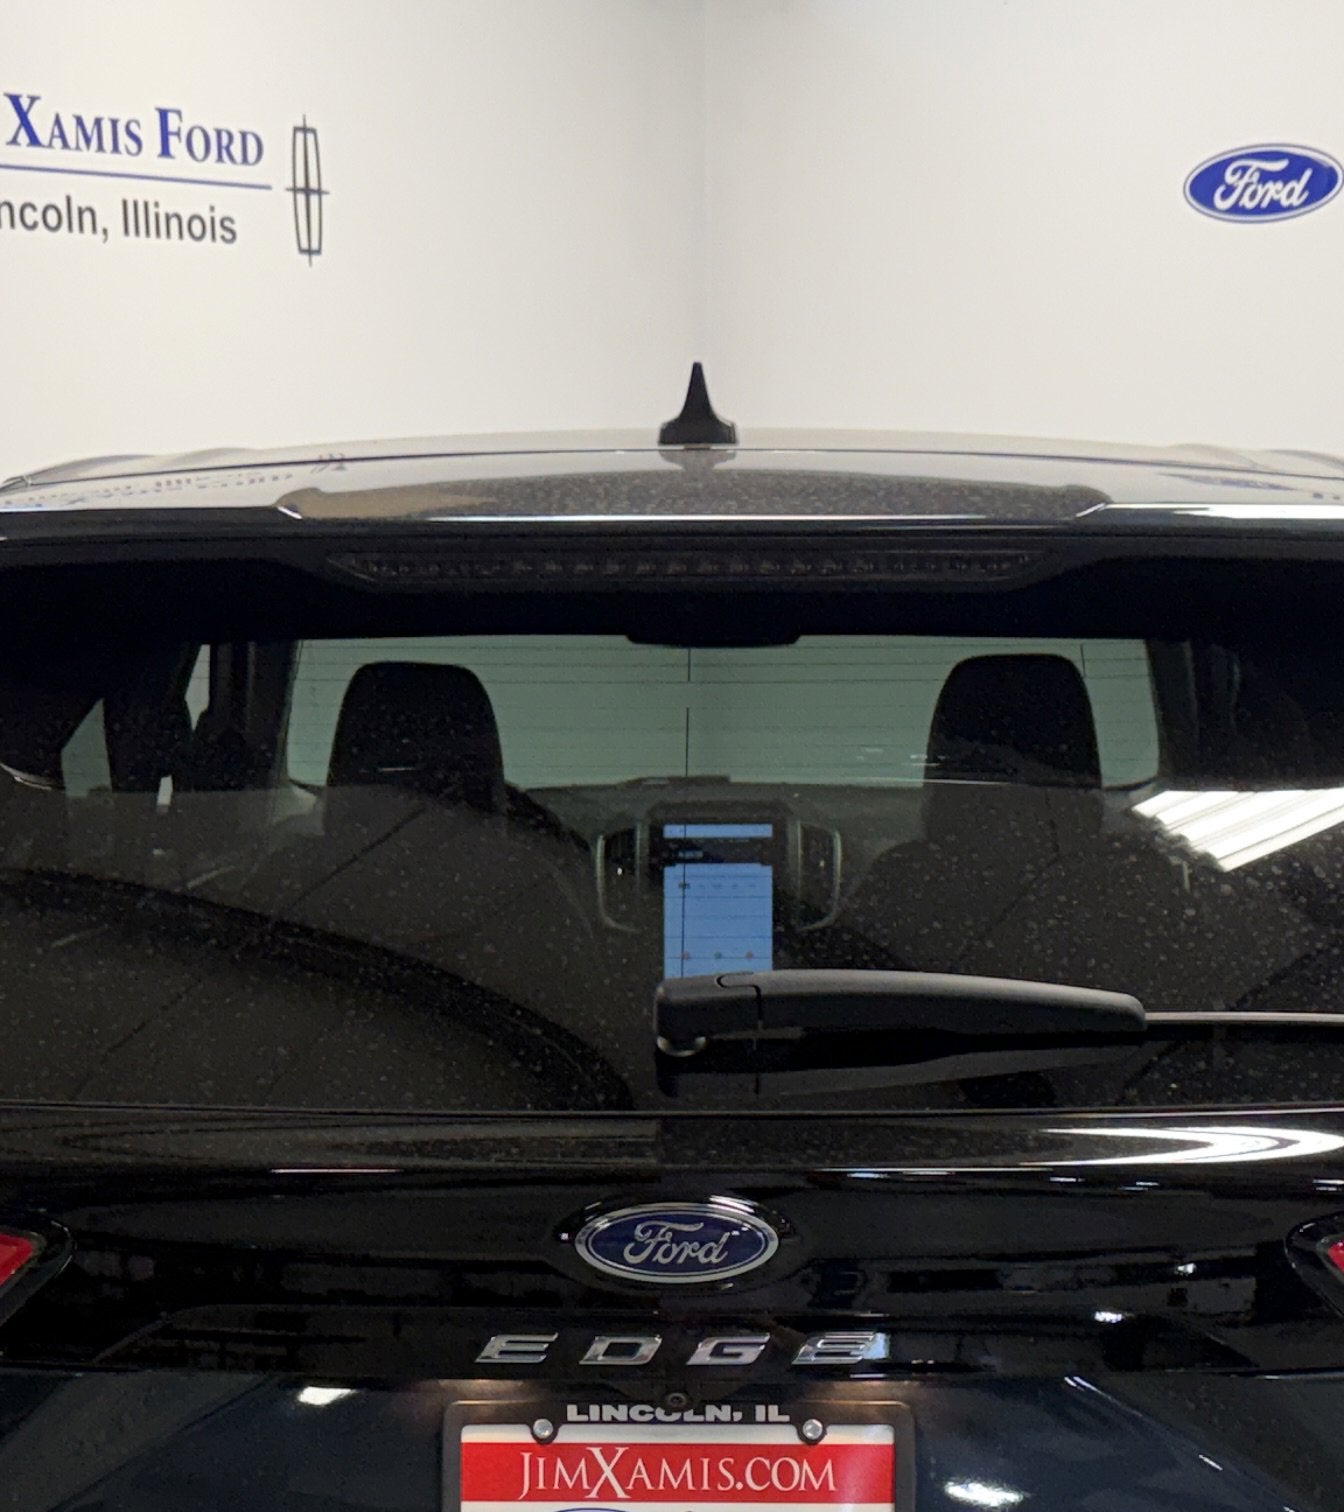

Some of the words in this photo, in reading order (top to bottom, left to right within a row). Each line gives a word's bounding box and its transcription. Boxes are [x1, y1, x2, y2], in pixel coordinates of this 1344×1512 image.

[3, 92, 143, 156] XAMIS
[155, 106, 264, 166] FORD
[1212, 156, 1313, 213] Ford
[121, 198, 238, 245] Illinois
[622, 1220, 730, 1265] Ford
[474, 1331, 890, 1366] EDGE
[755, 1404, 791, 1422] IL
